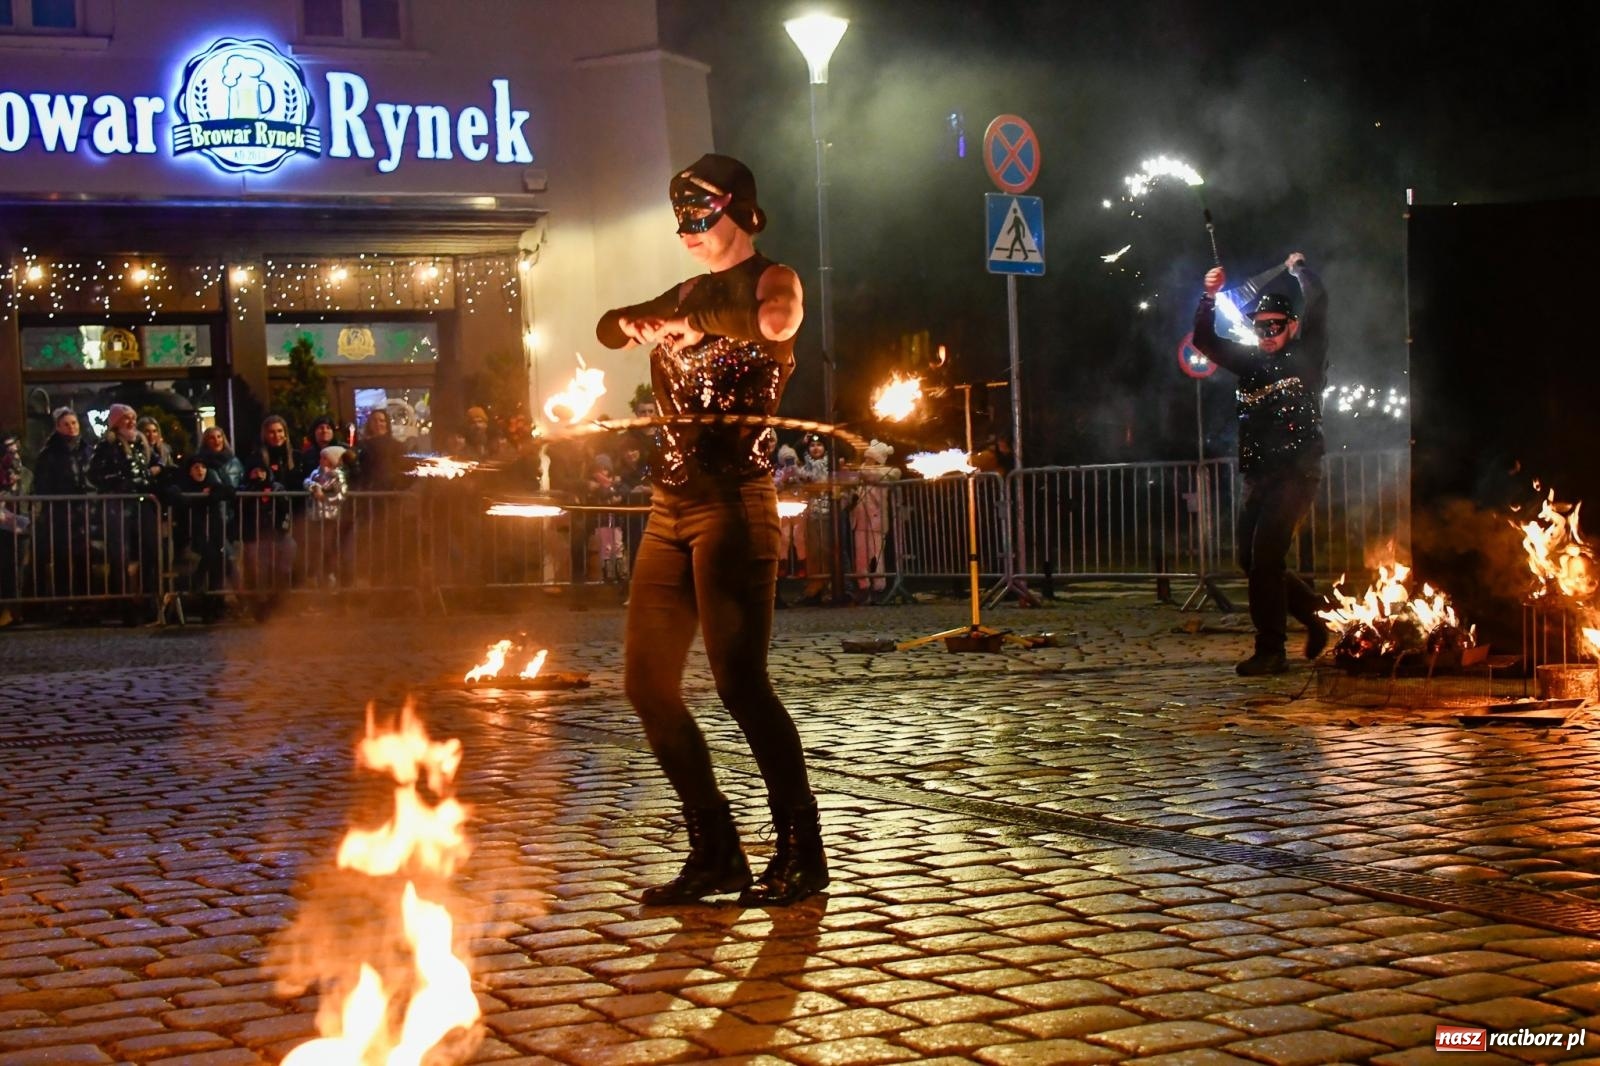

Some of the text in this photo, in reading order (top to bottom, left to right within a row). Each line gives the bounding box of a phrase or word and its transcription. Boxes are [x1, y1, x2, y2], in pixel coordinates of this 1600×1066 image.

[189, 121, 305, 148] Browar Rynek
[325, 72, 533, 172] Rynek
